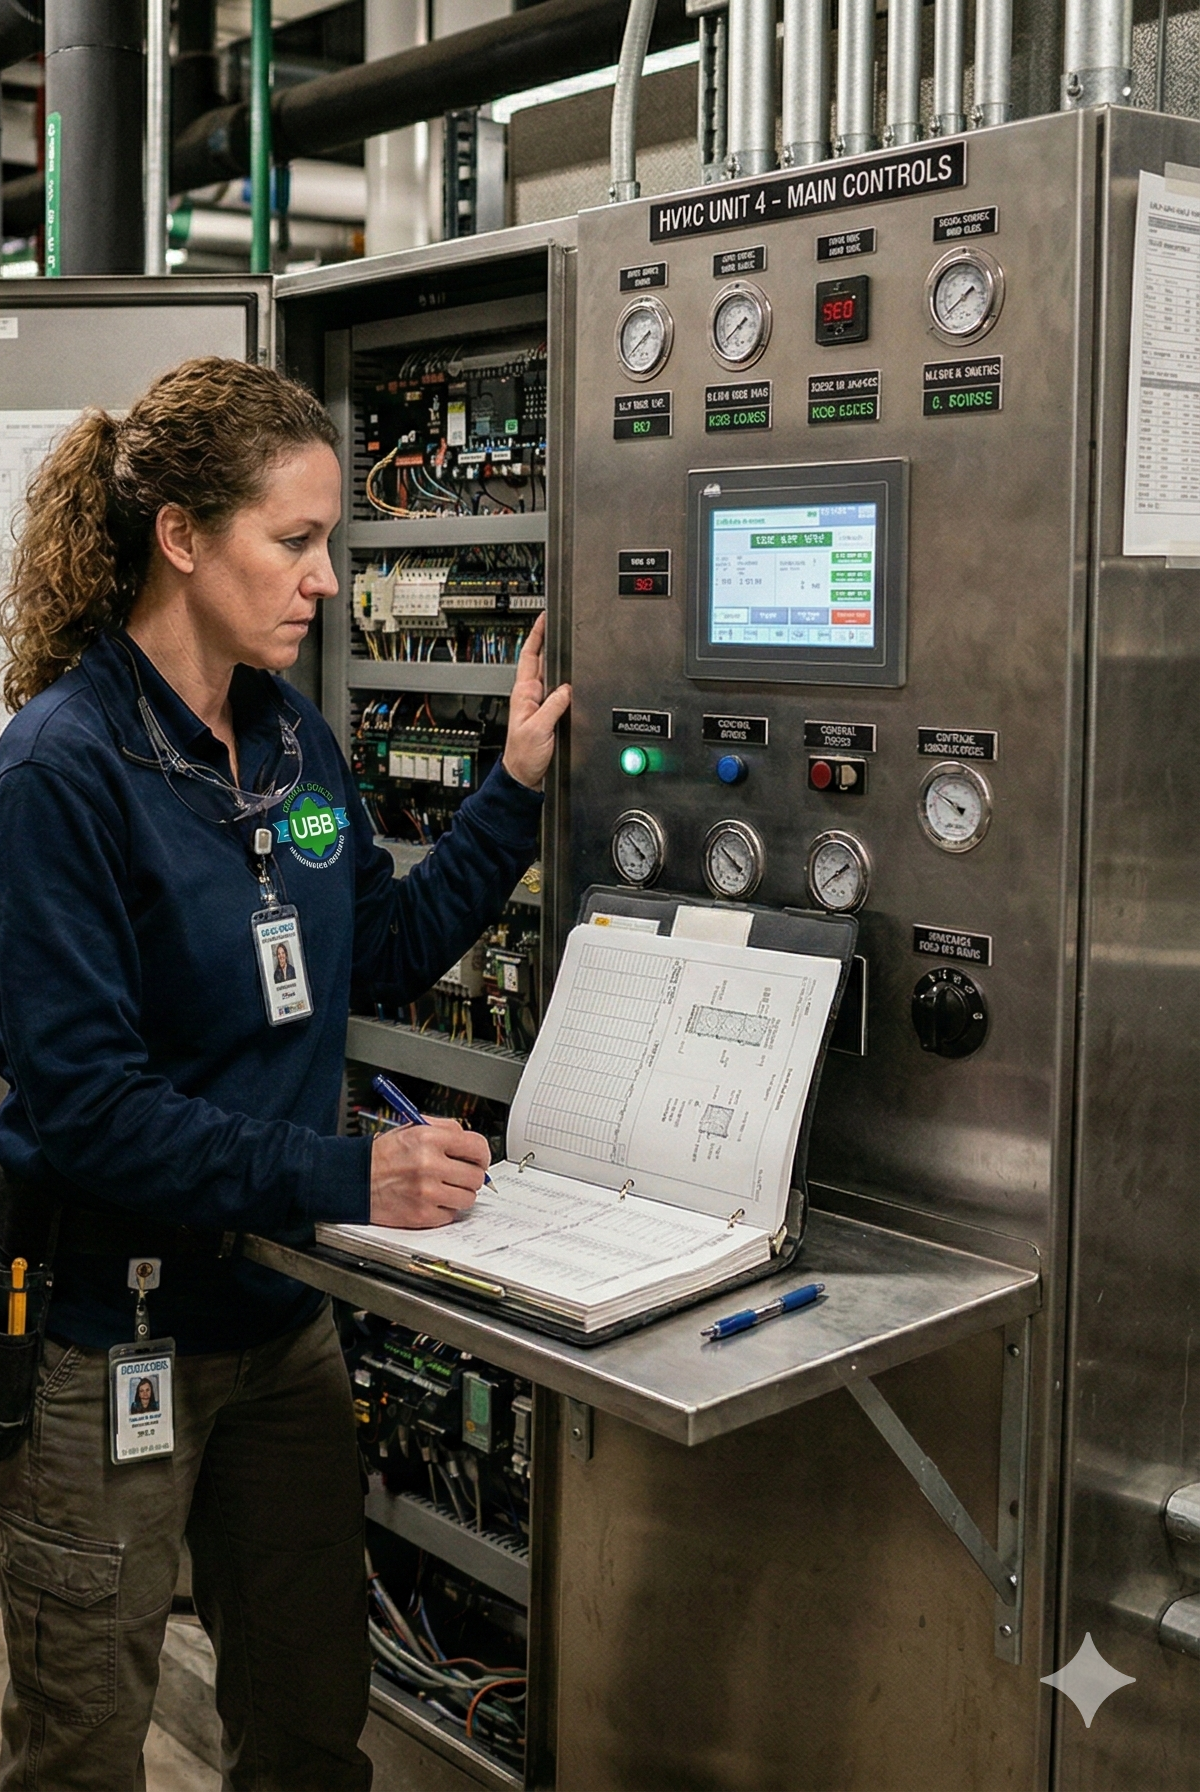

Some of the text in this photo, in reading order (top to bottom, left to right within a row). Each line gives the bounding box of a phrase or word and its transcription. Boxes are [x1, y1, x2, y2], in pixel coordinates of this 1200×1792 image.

[709, 193, 751, 224] UNIT
[754, 190, 767, 215] 4
[787, 176, 837, 210] MAIN
[842, 154, 953, 199] CONTROLS
[291, 813, 335, 839] UBB
